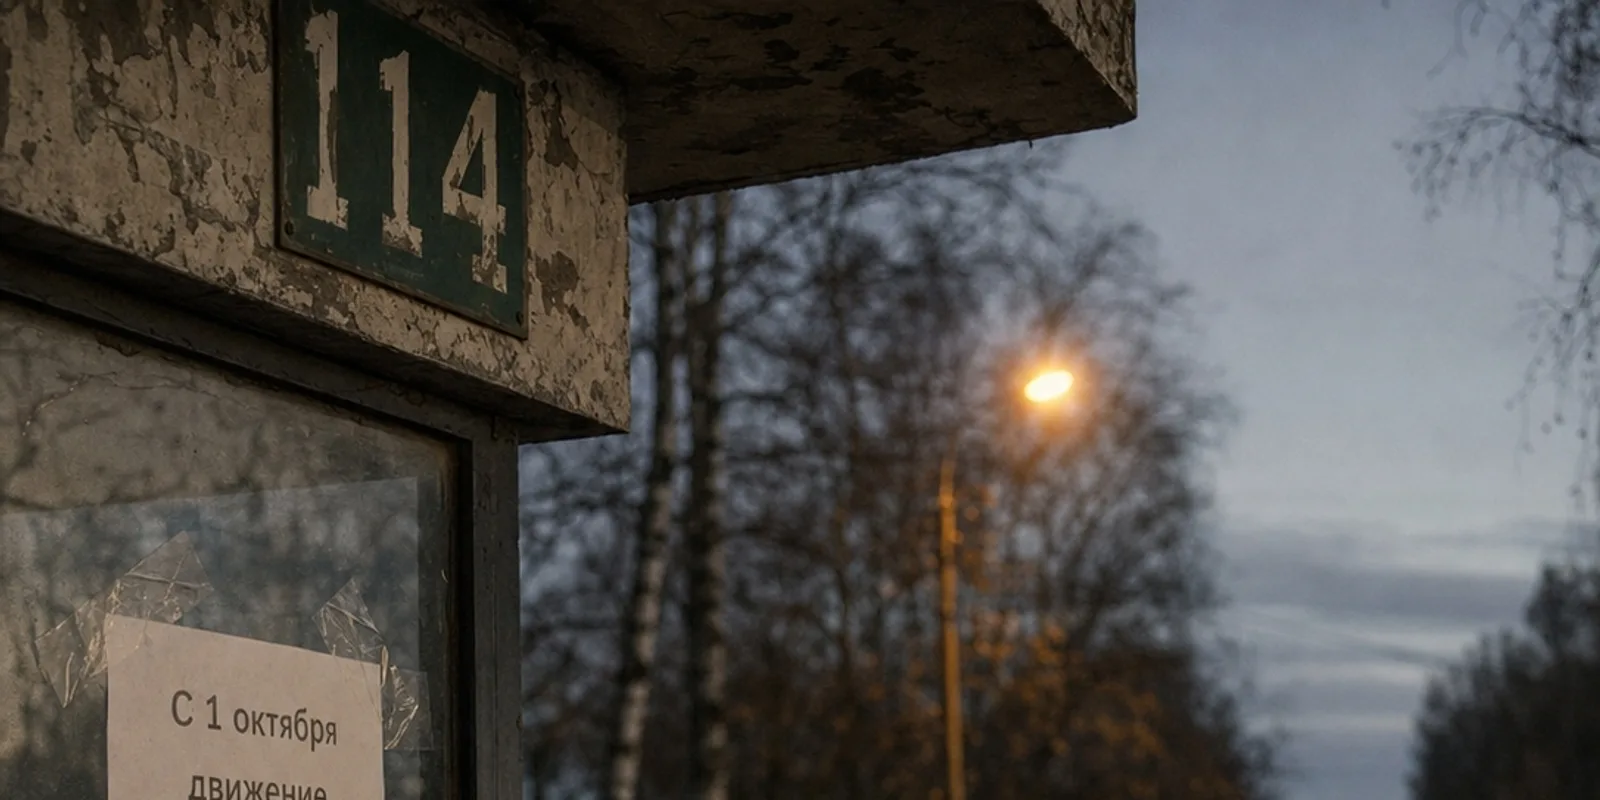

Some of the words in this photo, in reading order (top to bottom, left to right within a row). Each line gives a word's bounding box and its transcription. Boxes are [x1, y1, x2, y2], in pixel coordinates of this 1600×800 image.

[305, 9, 507, 294] 114
[171, 690, 193, 727] С
[206, 695, 221, 730] 1
[233, 708, 337, 751] октября
